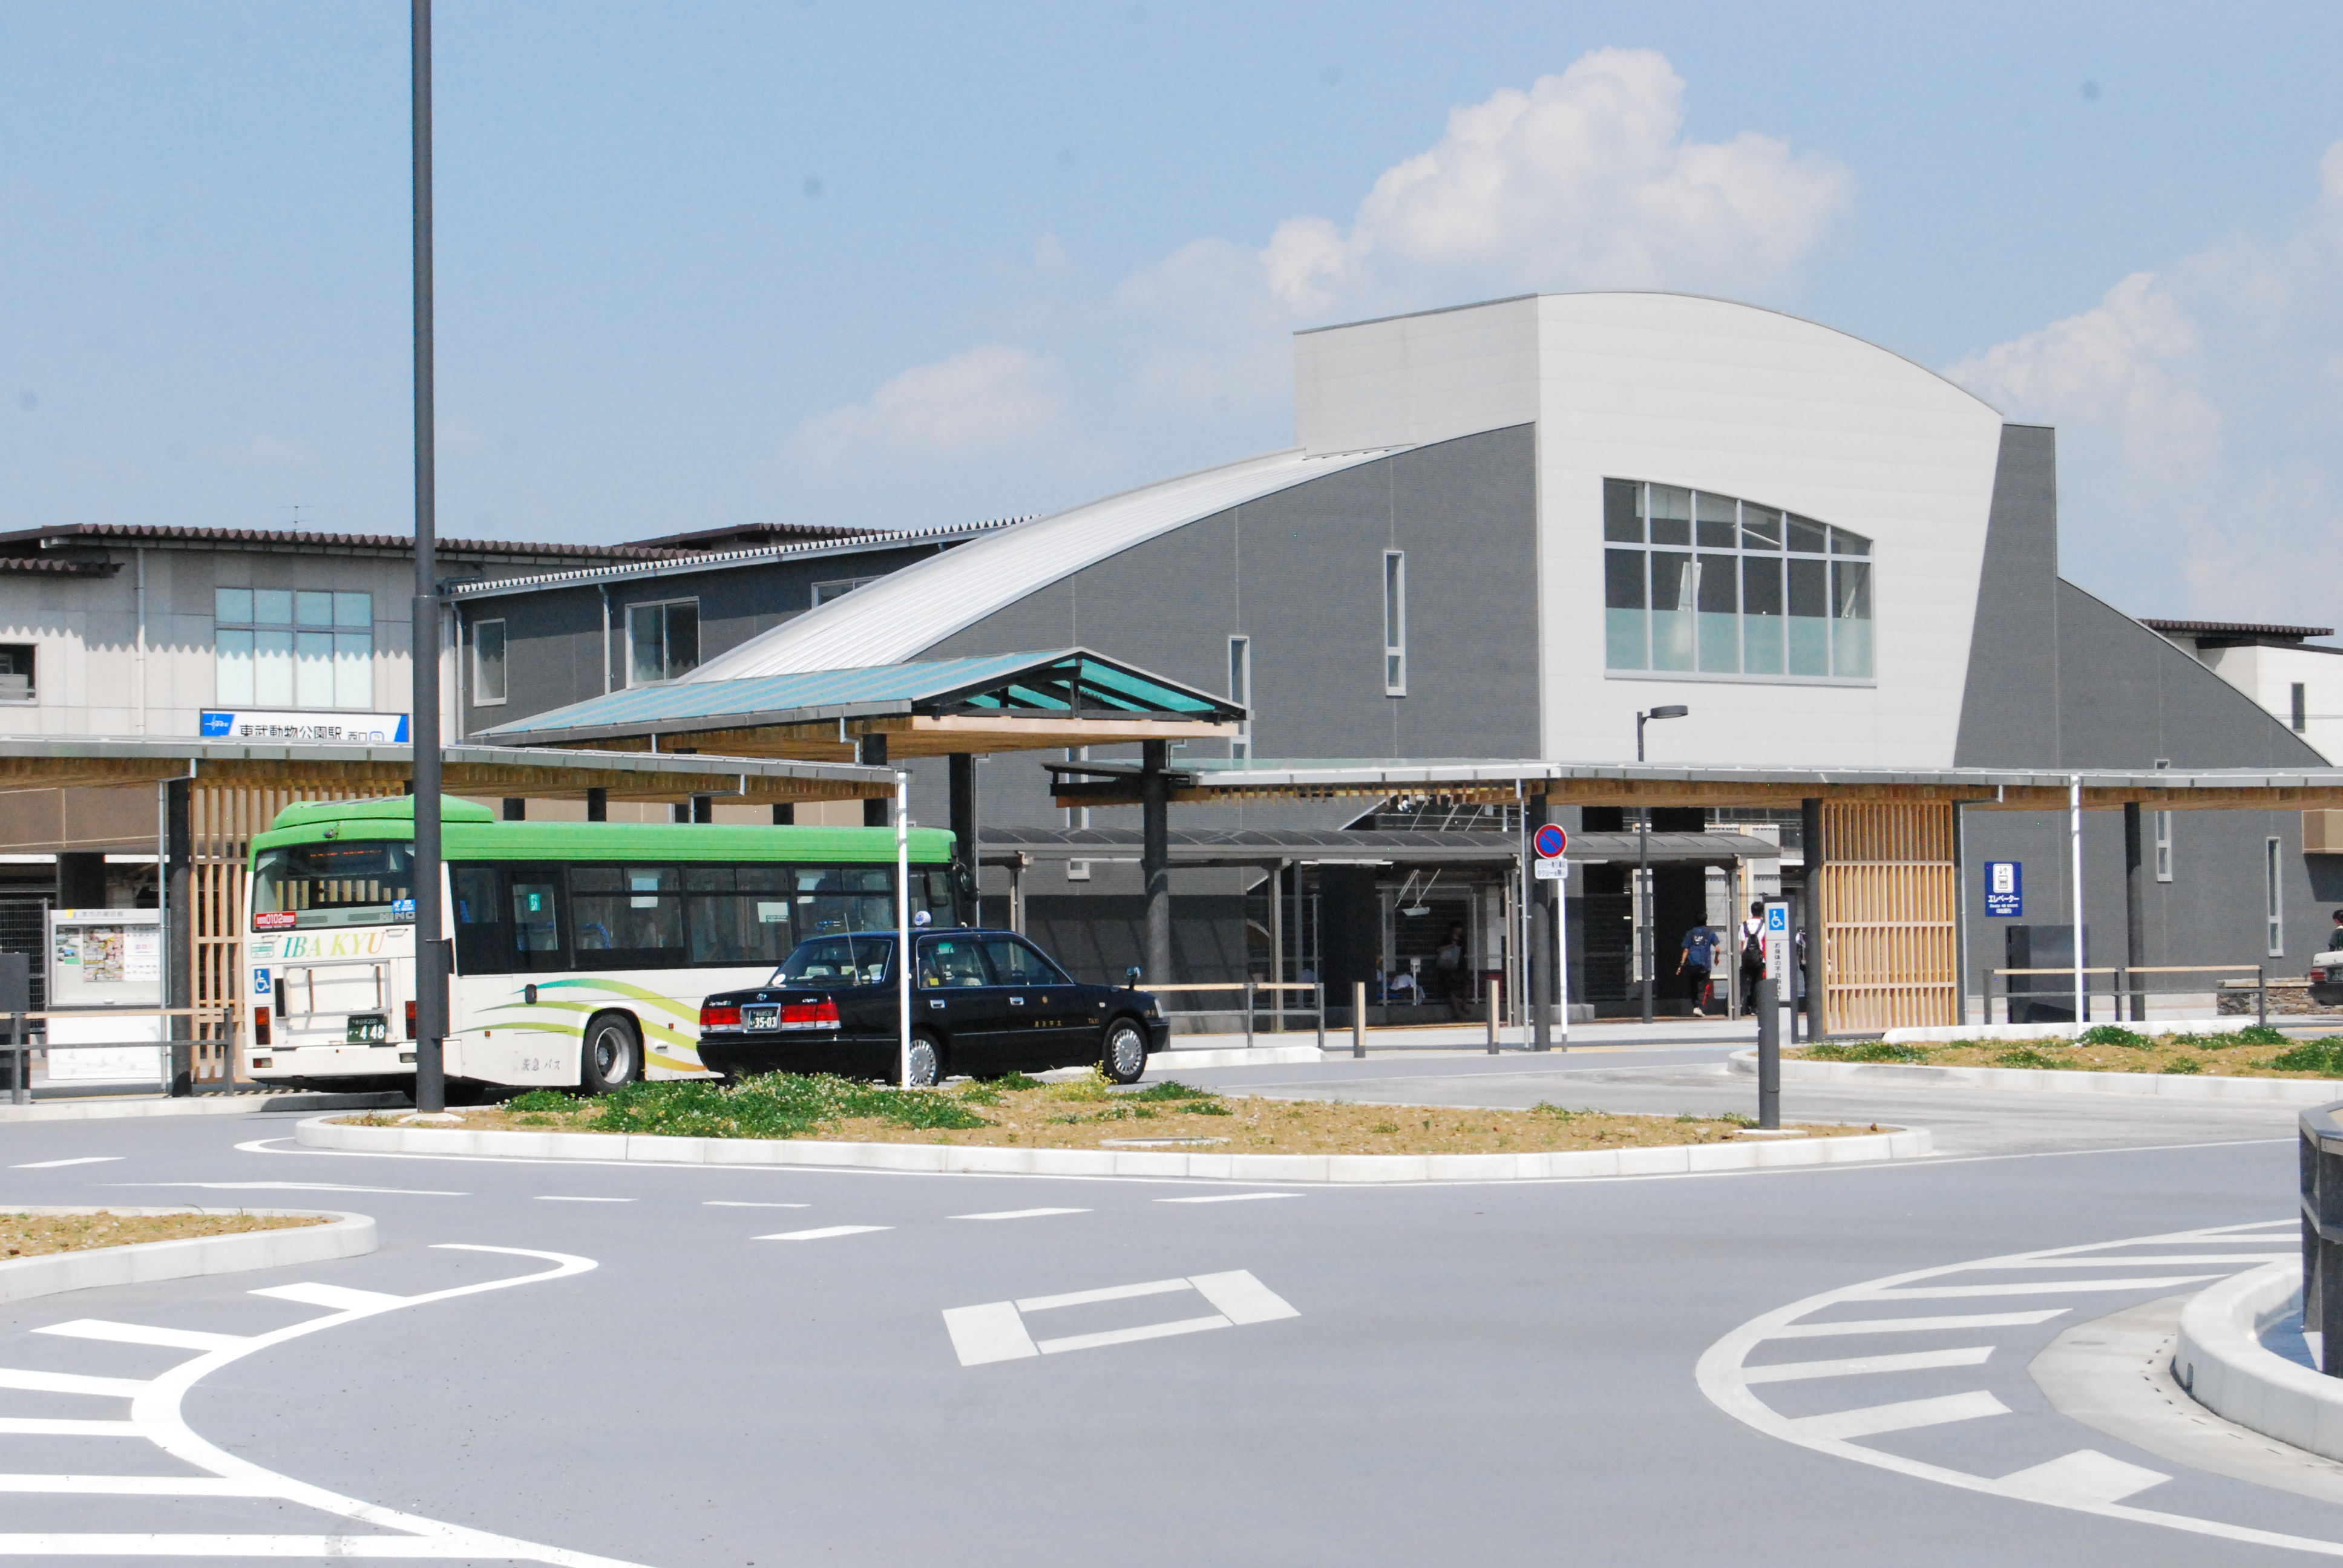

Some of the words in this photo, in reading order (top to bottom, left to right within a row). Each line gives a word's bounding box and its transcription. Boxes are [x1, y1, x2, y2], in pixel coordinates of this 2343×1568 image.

[1988, 895, 2020, 903] エレベーター
[266, 913, 283, 925] 0102
